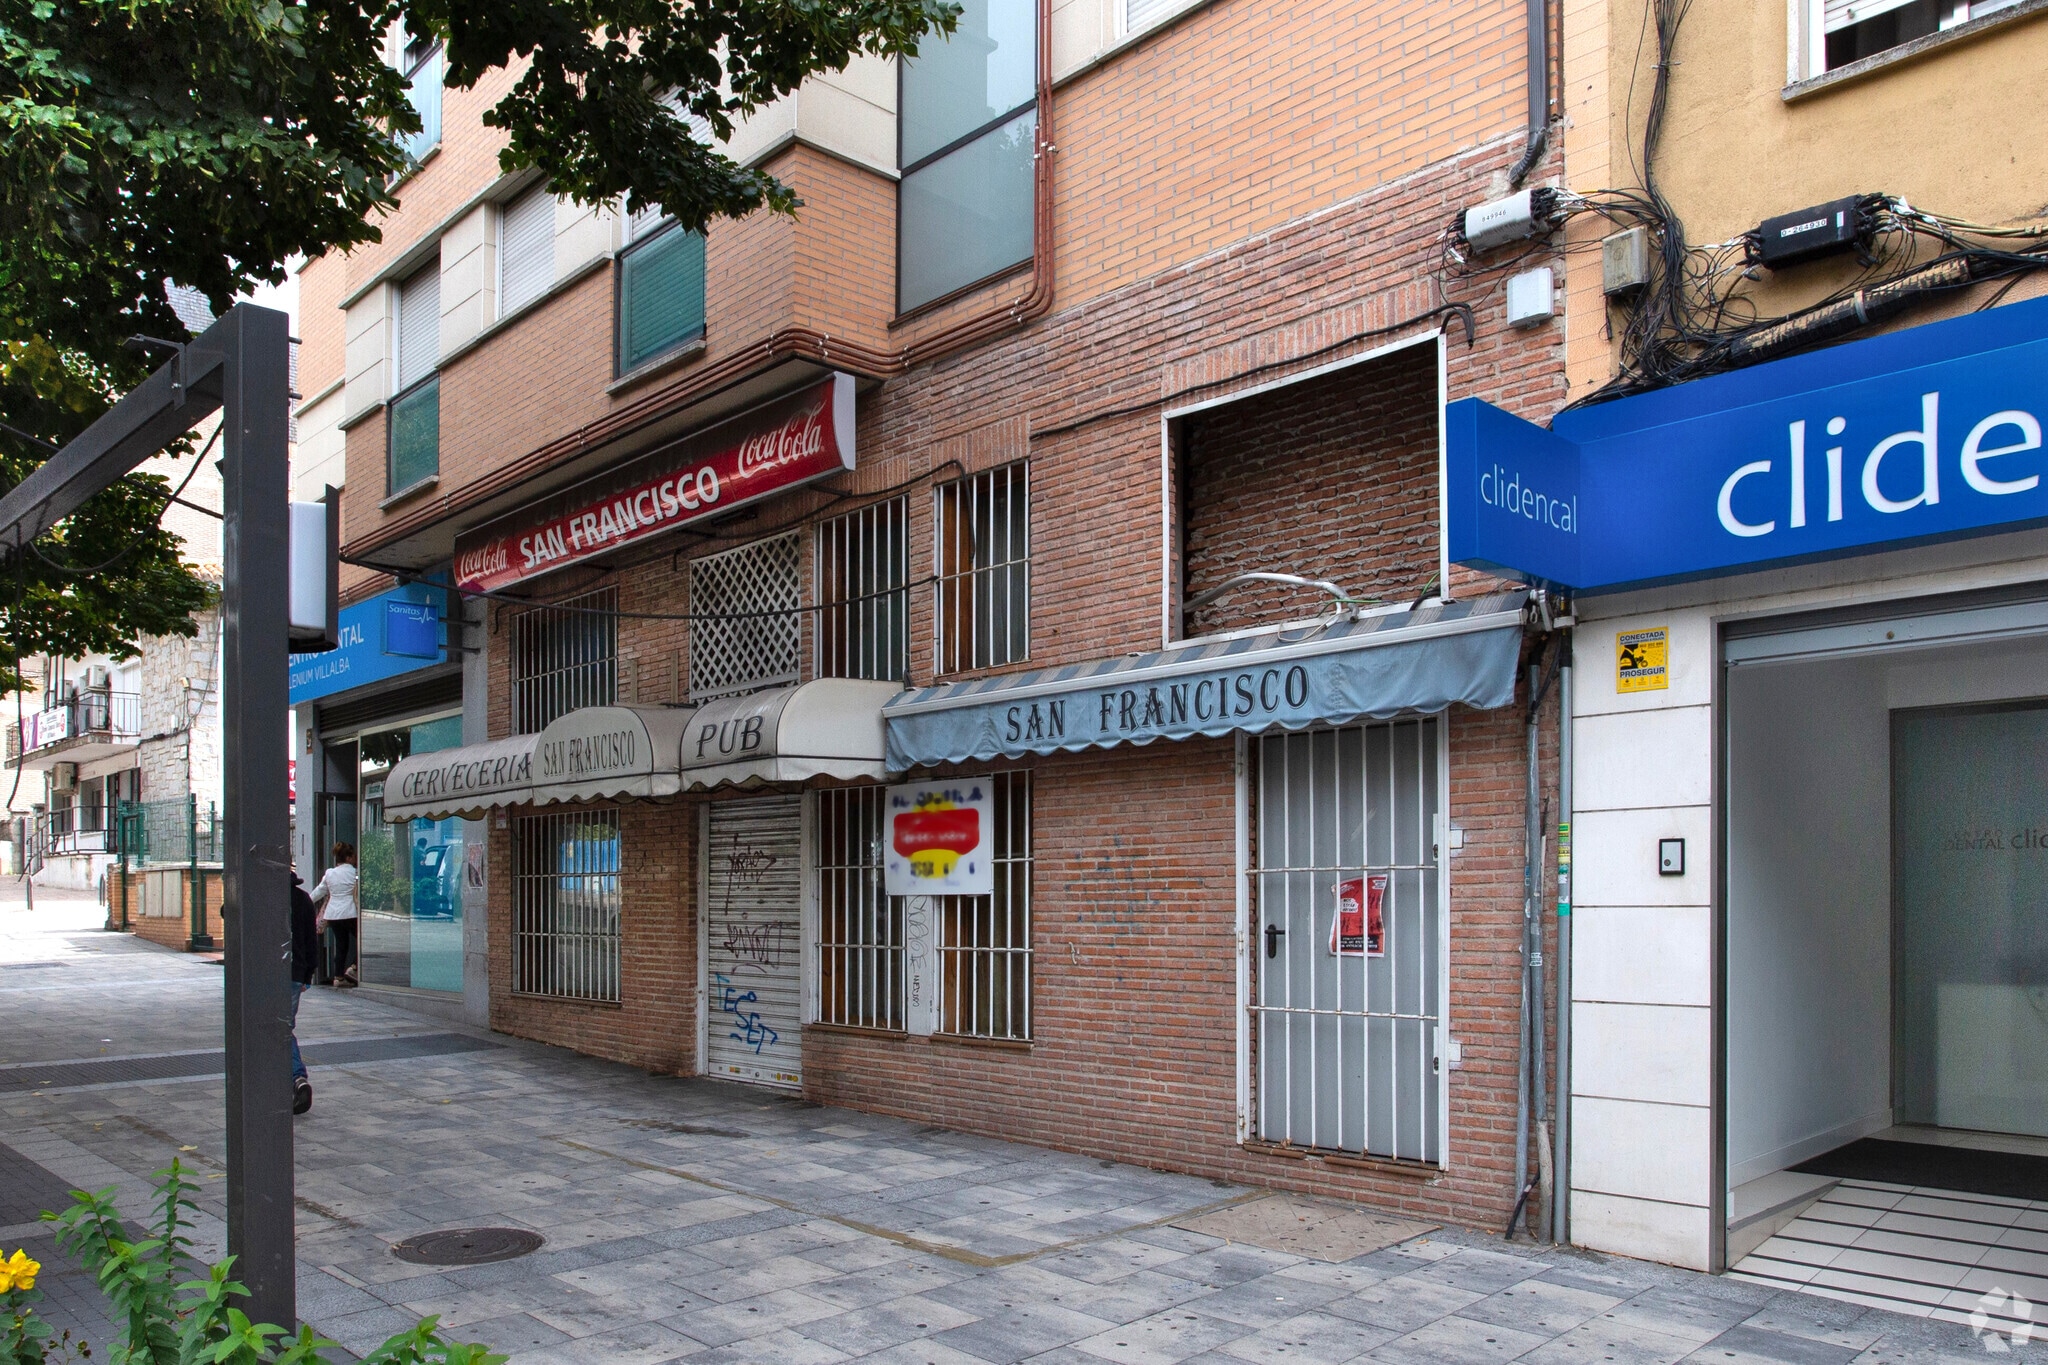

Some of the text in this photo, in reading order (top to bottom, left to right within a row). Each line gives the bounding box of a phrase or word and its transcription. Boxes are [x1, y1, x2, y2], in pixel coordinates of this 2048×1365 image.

[738, 400, 827, 478] Coca-Cola
[1716, 391, 2043, 538] clide
[520, 524, 568, 569] SAN
[569, 466, 720, 551] FRANCISCO
[1480, 463, 1577, 534] clidencal
[460, 538, 509, 583] Coca-Cola
[388, 604, 421, 616] Sanitas
[1620, 631, 1665, 642] CONECTADA
[289, 668, 314, 689] LENIUM
[314, 656, 350, 681] VILLALBA
[1620, 666, 1665, 678] PROSEGUR
[1005, 665, 1310, 743] SAN FRANCISCO
[543, 730, 636, 778] SAN FRANCISCO
[696, 715, 765, 759] PUB
[402, 752, 532, 799] CERVECERIA
